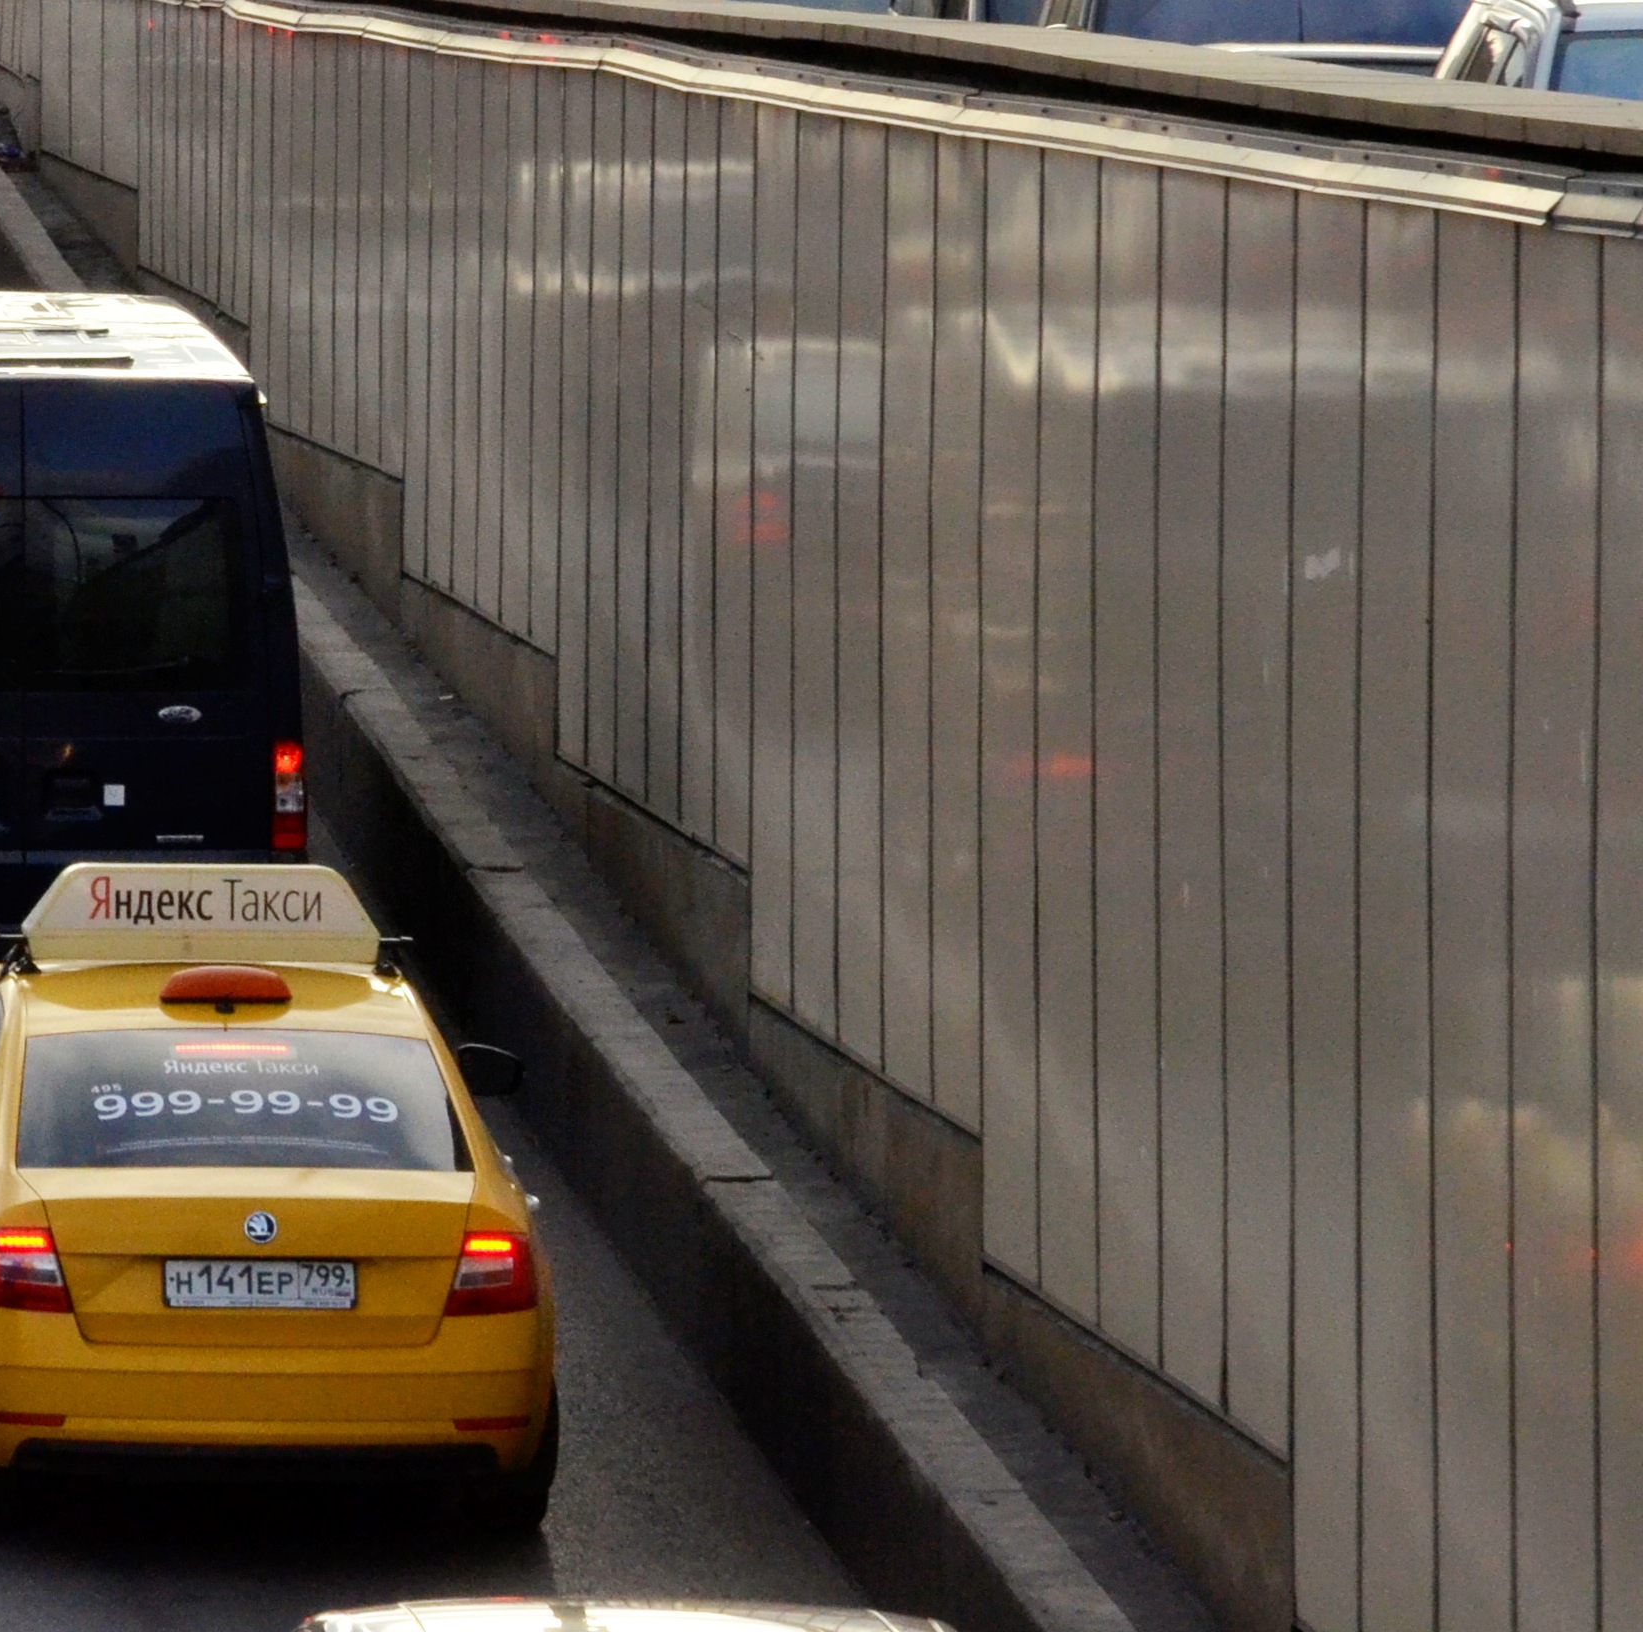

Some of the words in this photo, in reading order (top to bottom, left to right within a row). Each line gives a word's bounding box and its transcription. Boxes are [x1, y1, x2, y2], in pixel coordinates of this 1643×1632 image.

[89, 875, 213, 925] Яндекс
[222, 878, 322, 923] Такси
[163, 1059, 249, 1076] Яндекс
[256, 1059, 320, 1076] Такси
[90, 1083, 123, 1094] 495
[93, 1089, 399, 1123] 999-99-99
[176, 1264, 293, 1295] Н141ЕР
[301, 1263, 347, 1287] 799
